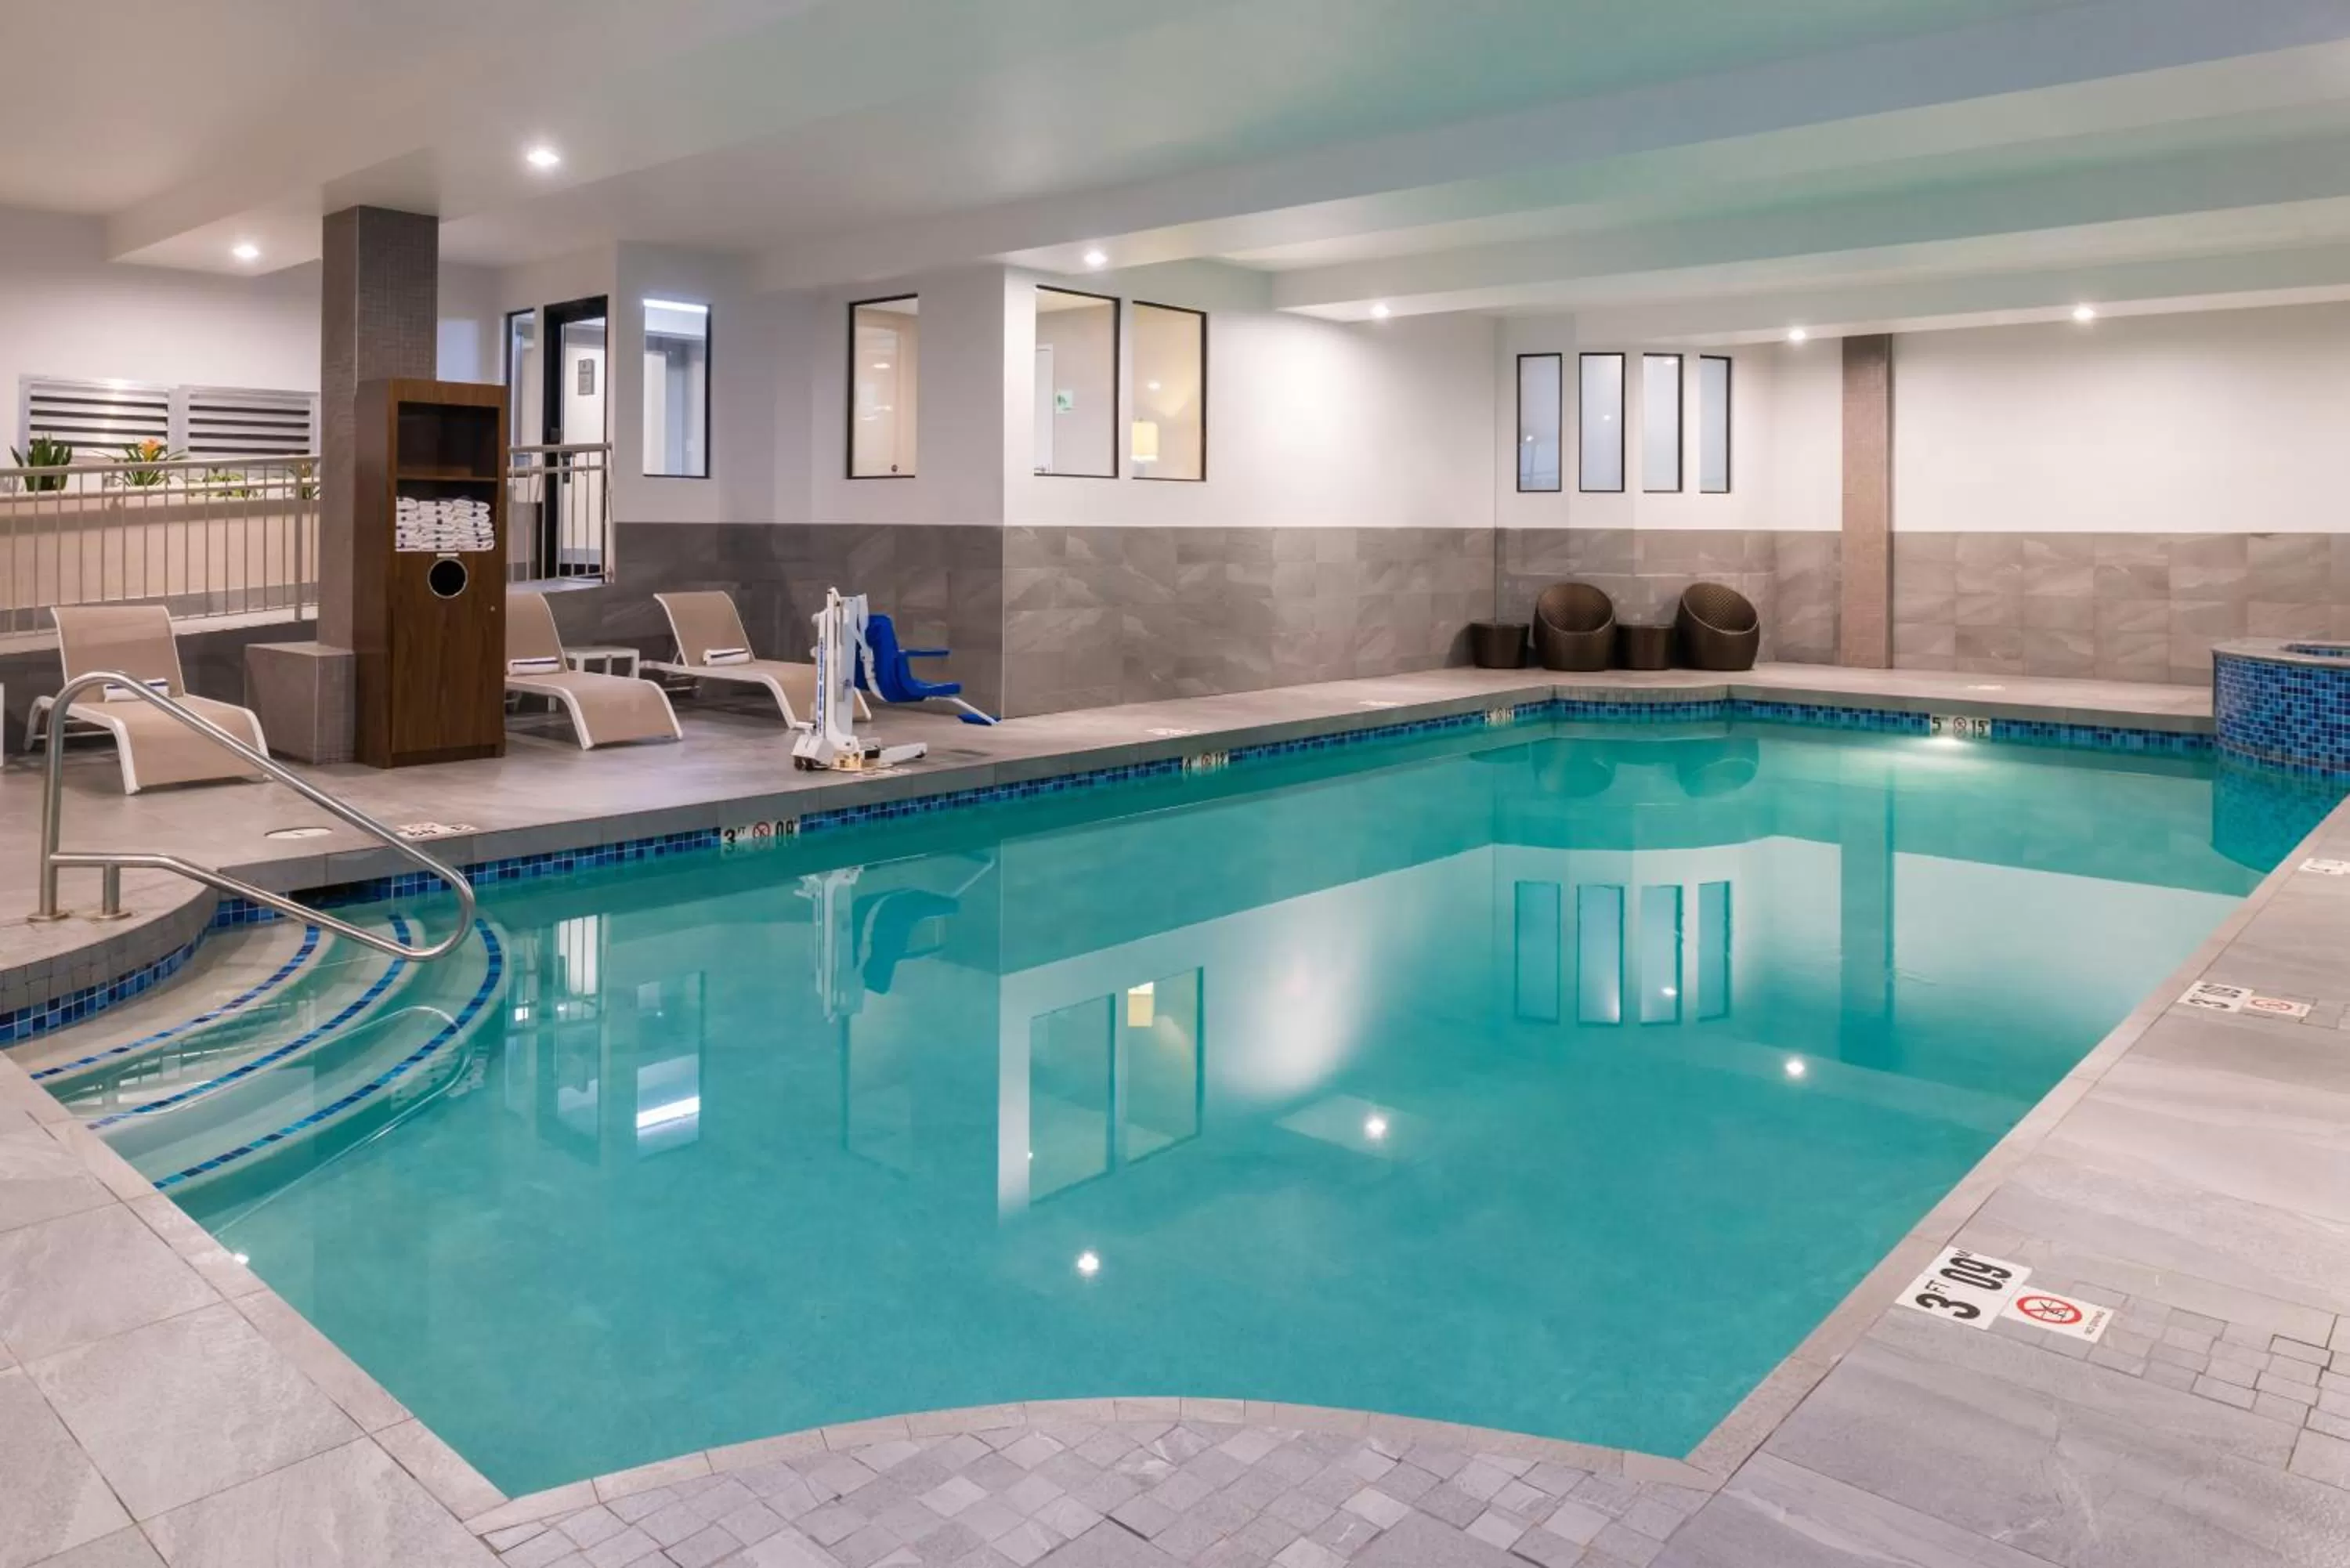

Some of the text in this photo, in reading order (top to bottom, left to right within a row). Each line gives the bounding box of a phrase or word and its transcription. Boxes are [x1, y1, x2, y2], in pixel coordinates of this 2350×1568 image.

[1932, 717, 1941, 735] 5
[1925, 1280, 1950, 1294] FT
[1915, 1293, 1981, 1319] 3
